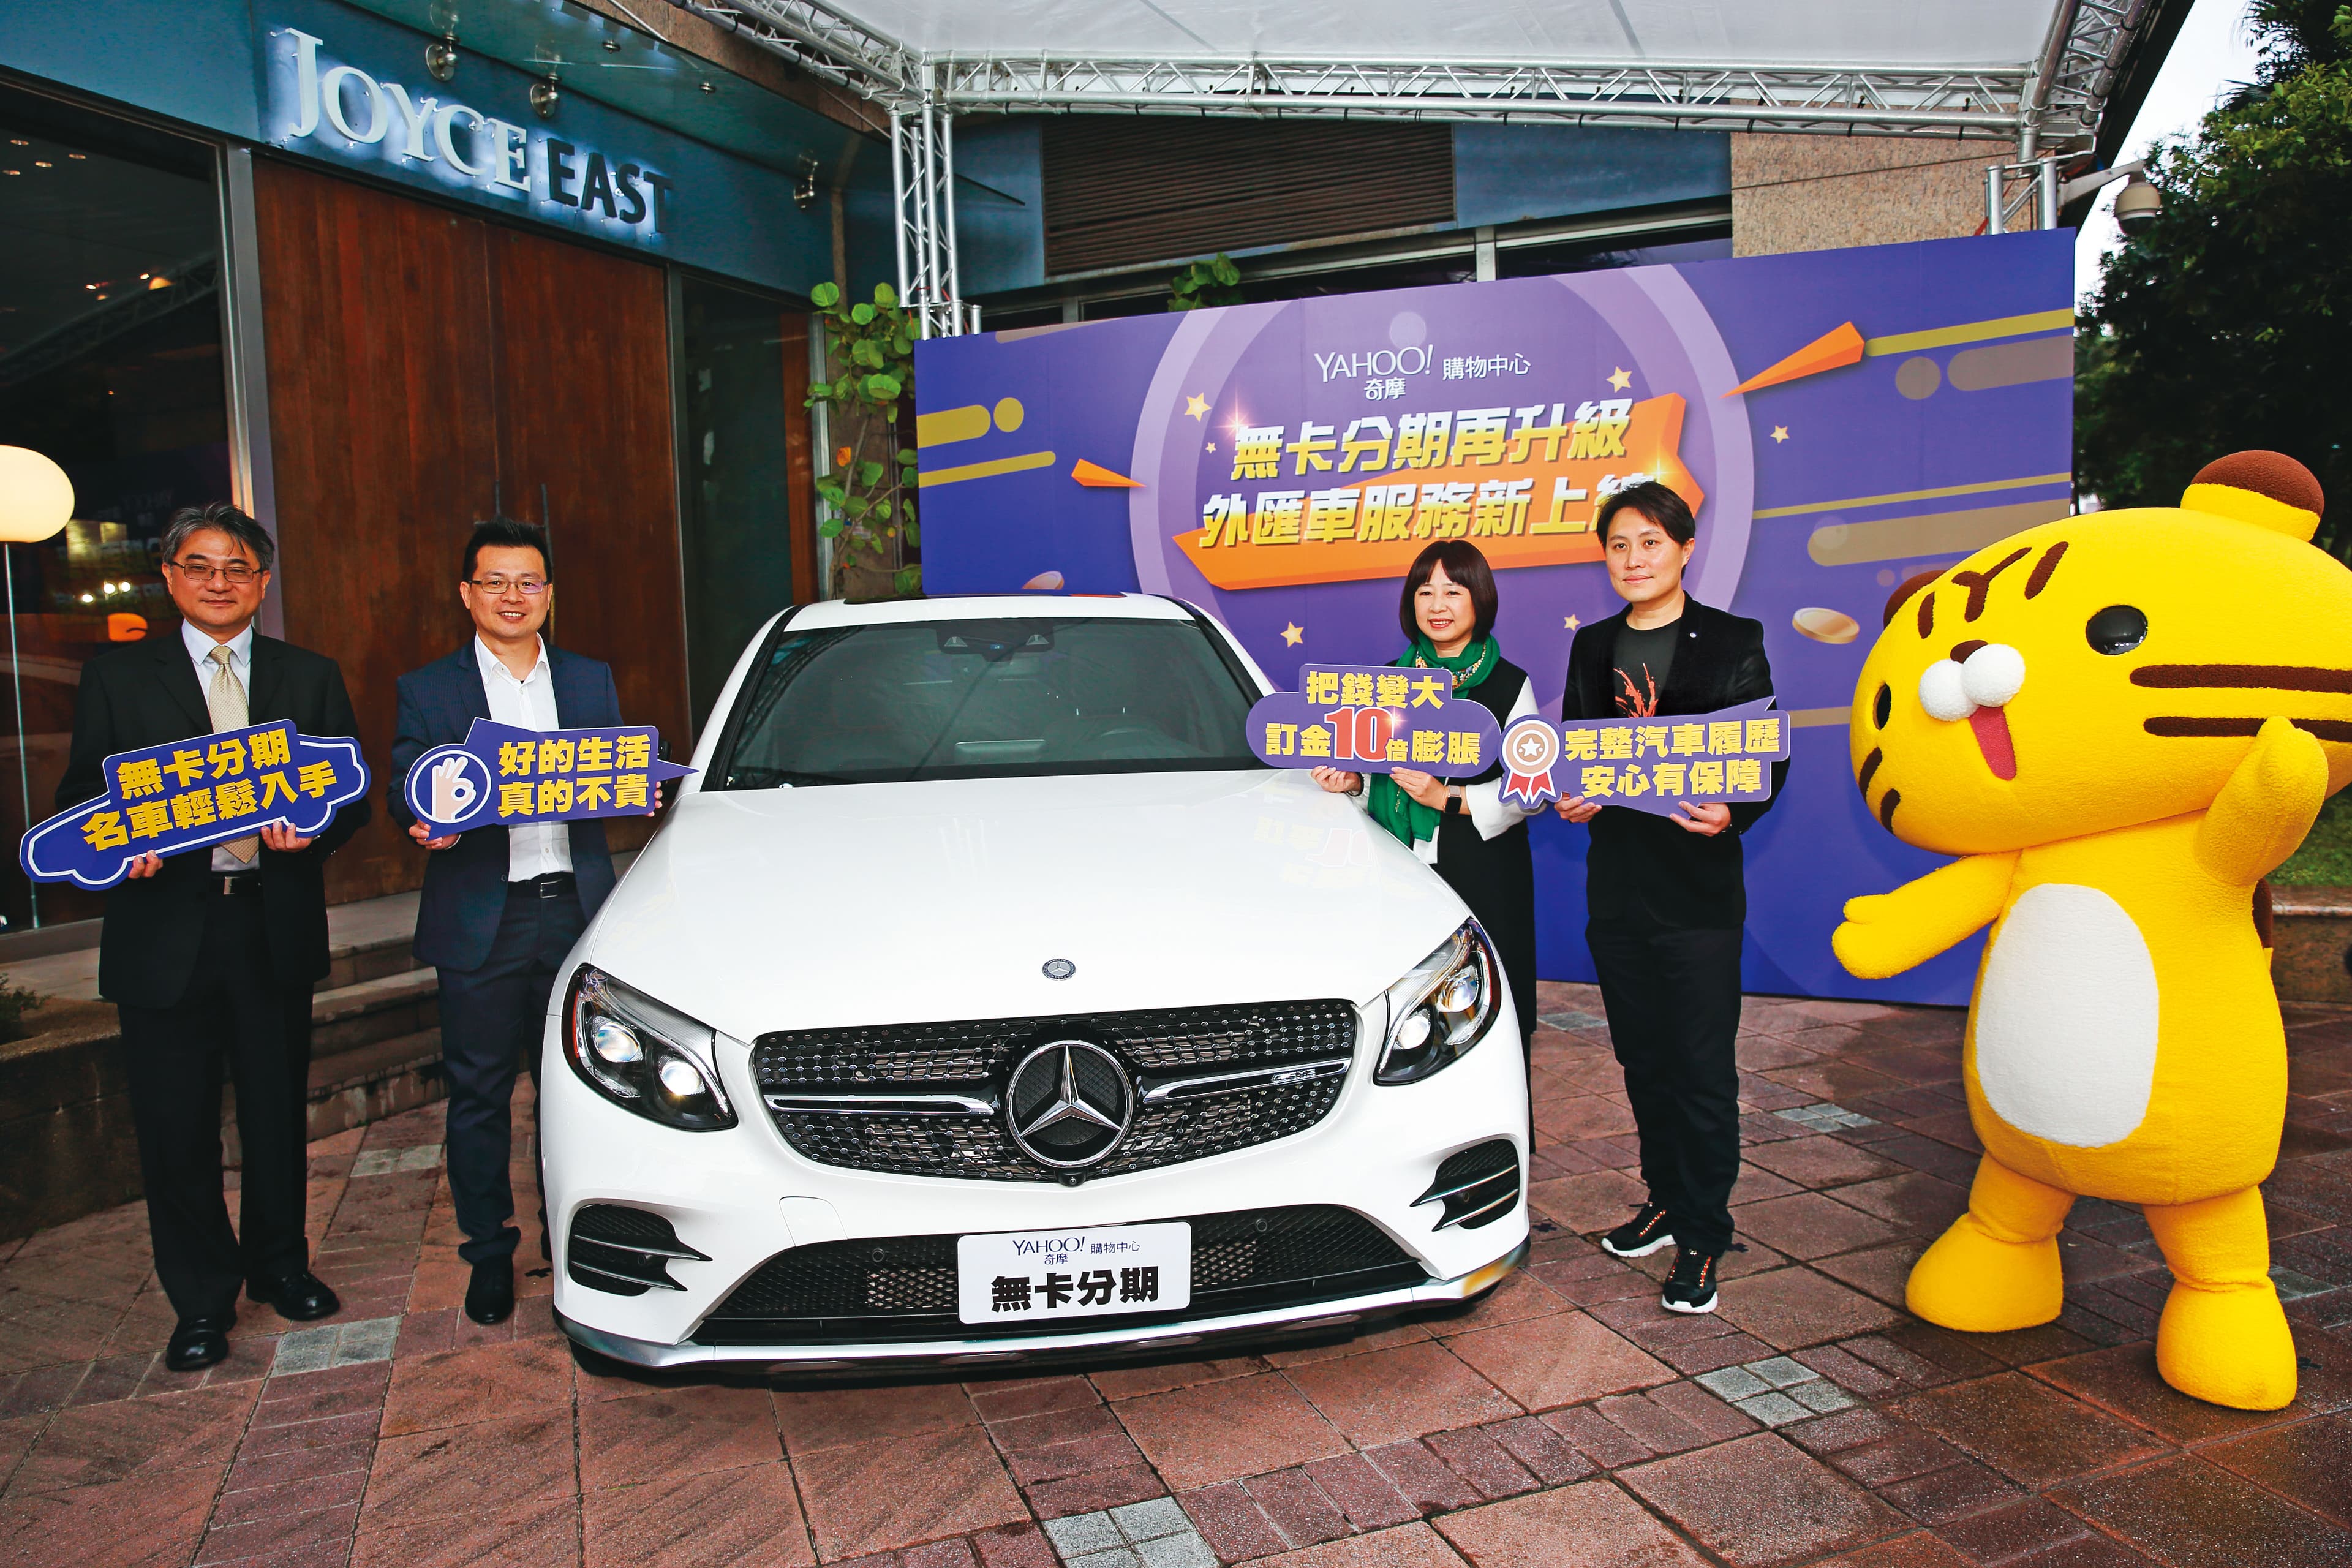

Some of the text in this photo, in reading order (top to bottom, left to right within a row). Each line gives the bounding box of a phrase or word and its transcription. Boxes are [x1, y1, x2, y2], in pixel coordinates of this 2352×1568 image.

[285, 27, 674, 234] JOYCE EAST
[1314, 344, 1531, 383] YAHOO! 購物中心
[1363, 379, 1406, 401] 奇摩
[1231, 399, 1634, 480] 無卡分期再升級
[1306, 672, 1445, 709] 把錢變大
[499, 734, 651, 777] 好的生活
[1565, 718, 1780, 761] 完整汽車履歷
[116, 728, 292, 800] 無卡分期
[1581, 758, 1762, 799] 安心有保障
[81, 760, 337, 851] 名車輕鬆入手
[498, 774, 649, 818] 真的不貴
[1012, 1236, 1140, 1256] YAHOO! 購物中心
[1043, 1253, 1069, 1265] 奇摩
[991, 1266, 1159, 1313] 無卡分期
